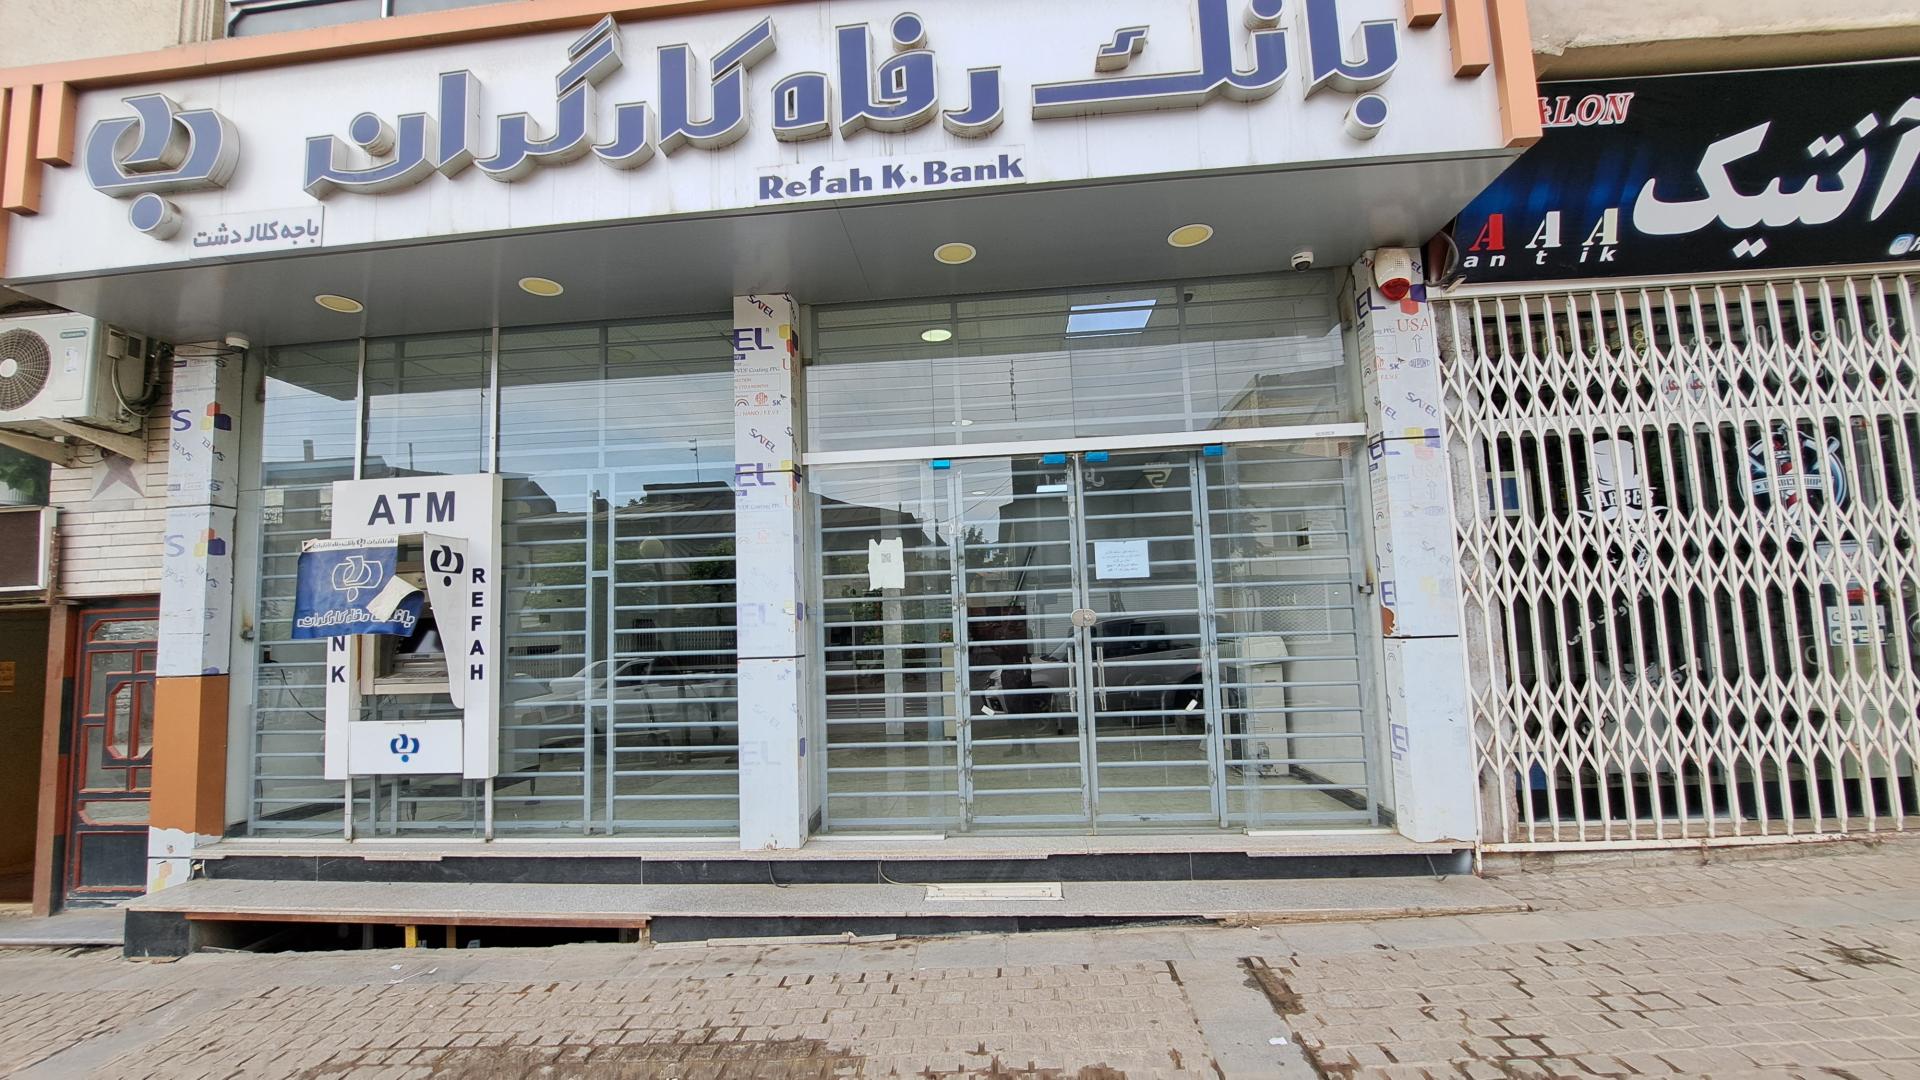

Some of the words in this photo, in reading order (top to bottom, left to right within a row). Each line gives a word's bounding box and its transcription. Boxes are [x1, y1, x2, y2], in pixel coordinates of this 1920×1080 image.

[771, 12, 1004, 141] رفاه
[1032, 0, 1400, 141] بانک
[303, 14, 779, 198] کارگران
[759, 165, 873, 200] Refah
[1633, 97, 1920, 259] آنتیک
[280, 218, 319, 245] باجه
[747, 294, 774, 318] SATEL
[1396, 318, 1429, 333] USA
[1406, 391, 1437, 418] SATEL
[749, 428, 775, 453] SATEL
[367, 490, 456, 526] ATM
[371, 609, 415, 628] بان
[470, 567, 485, 681] REFAH
[331, 636, 346, 683] NK
